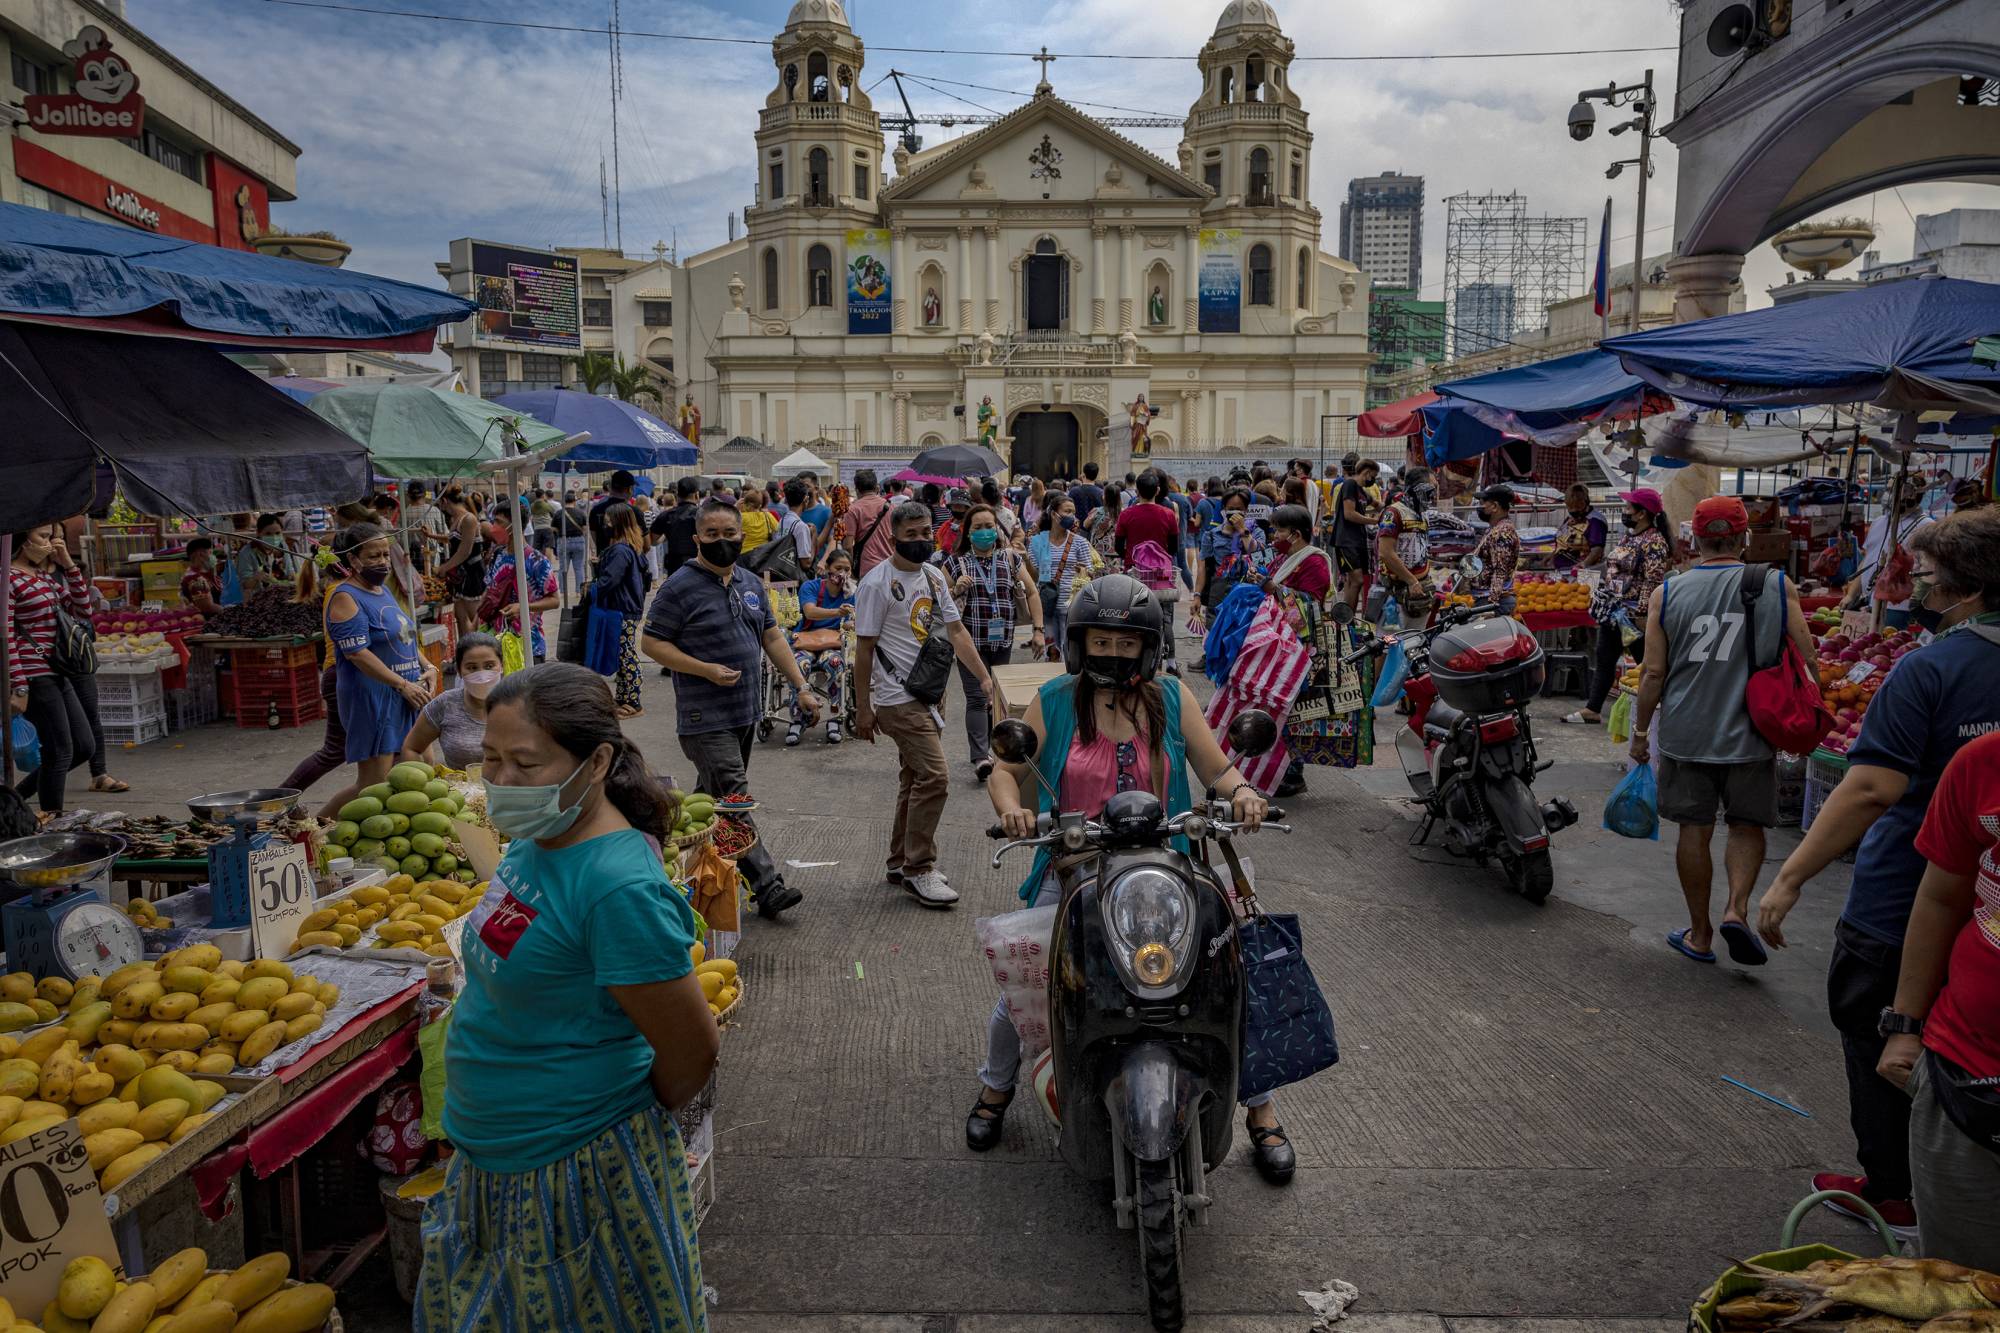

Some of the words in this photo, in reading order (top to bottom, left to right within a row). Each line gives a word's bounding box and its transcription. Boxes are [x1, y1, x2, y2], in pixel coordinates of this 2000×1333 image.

[33, 103, 133, 127] Jollibee
[106, 184, 160, 228] Jollibee
[861, 312, 880, 320] 2022
[1688, 612, 1745, 661] 27
[1290, 698, 1324, 714] ORK
[251, 846, 295, 866] ZAMBALES
[259, 863, 302, 911] 50
[258, 906, 301, 924] TUMPOK
[0, 1161, 69, 1243] 0
[0, 1242, 62, 1284] POK
